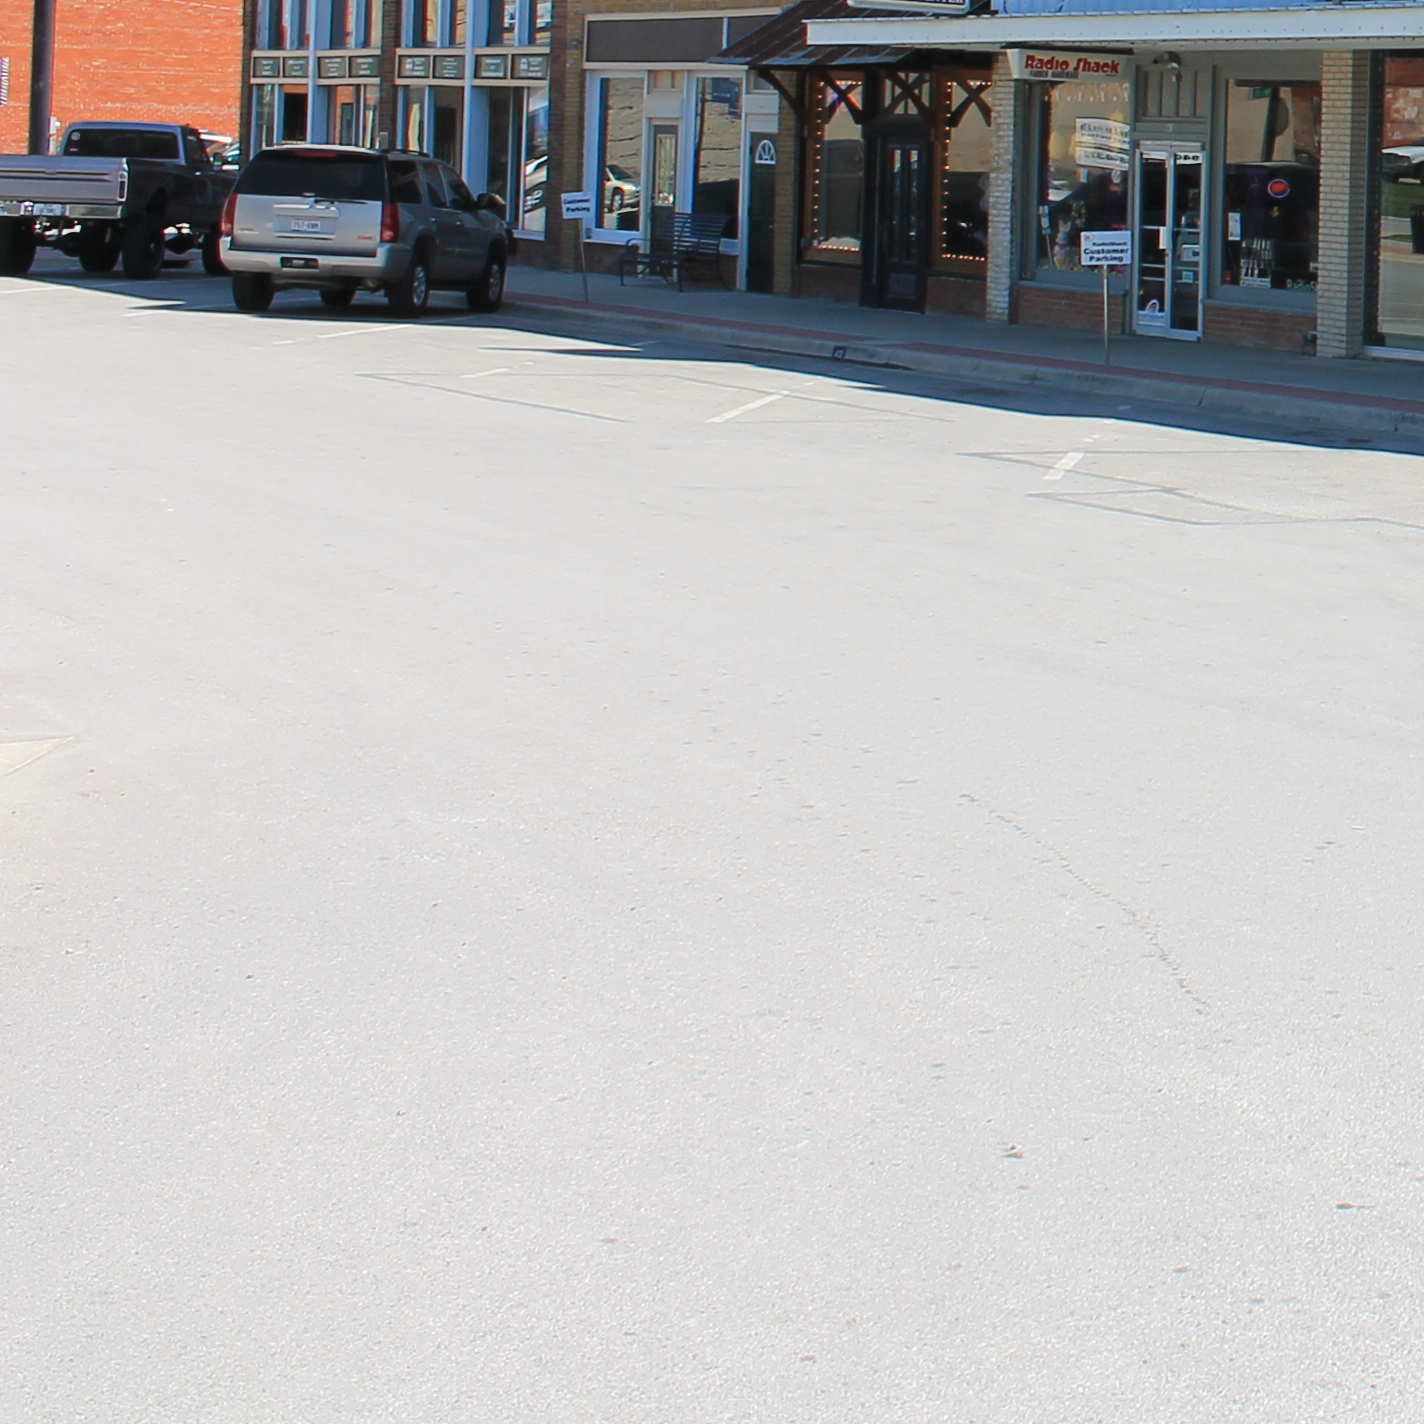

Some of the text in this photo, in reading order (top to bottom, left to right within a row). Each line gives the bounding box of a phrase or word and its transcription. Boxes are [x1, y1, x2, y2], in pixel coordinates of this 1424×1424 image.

[1025, 55, 1120, 74] Radio Shack
[1089, 256, 1124, 264] Parking
